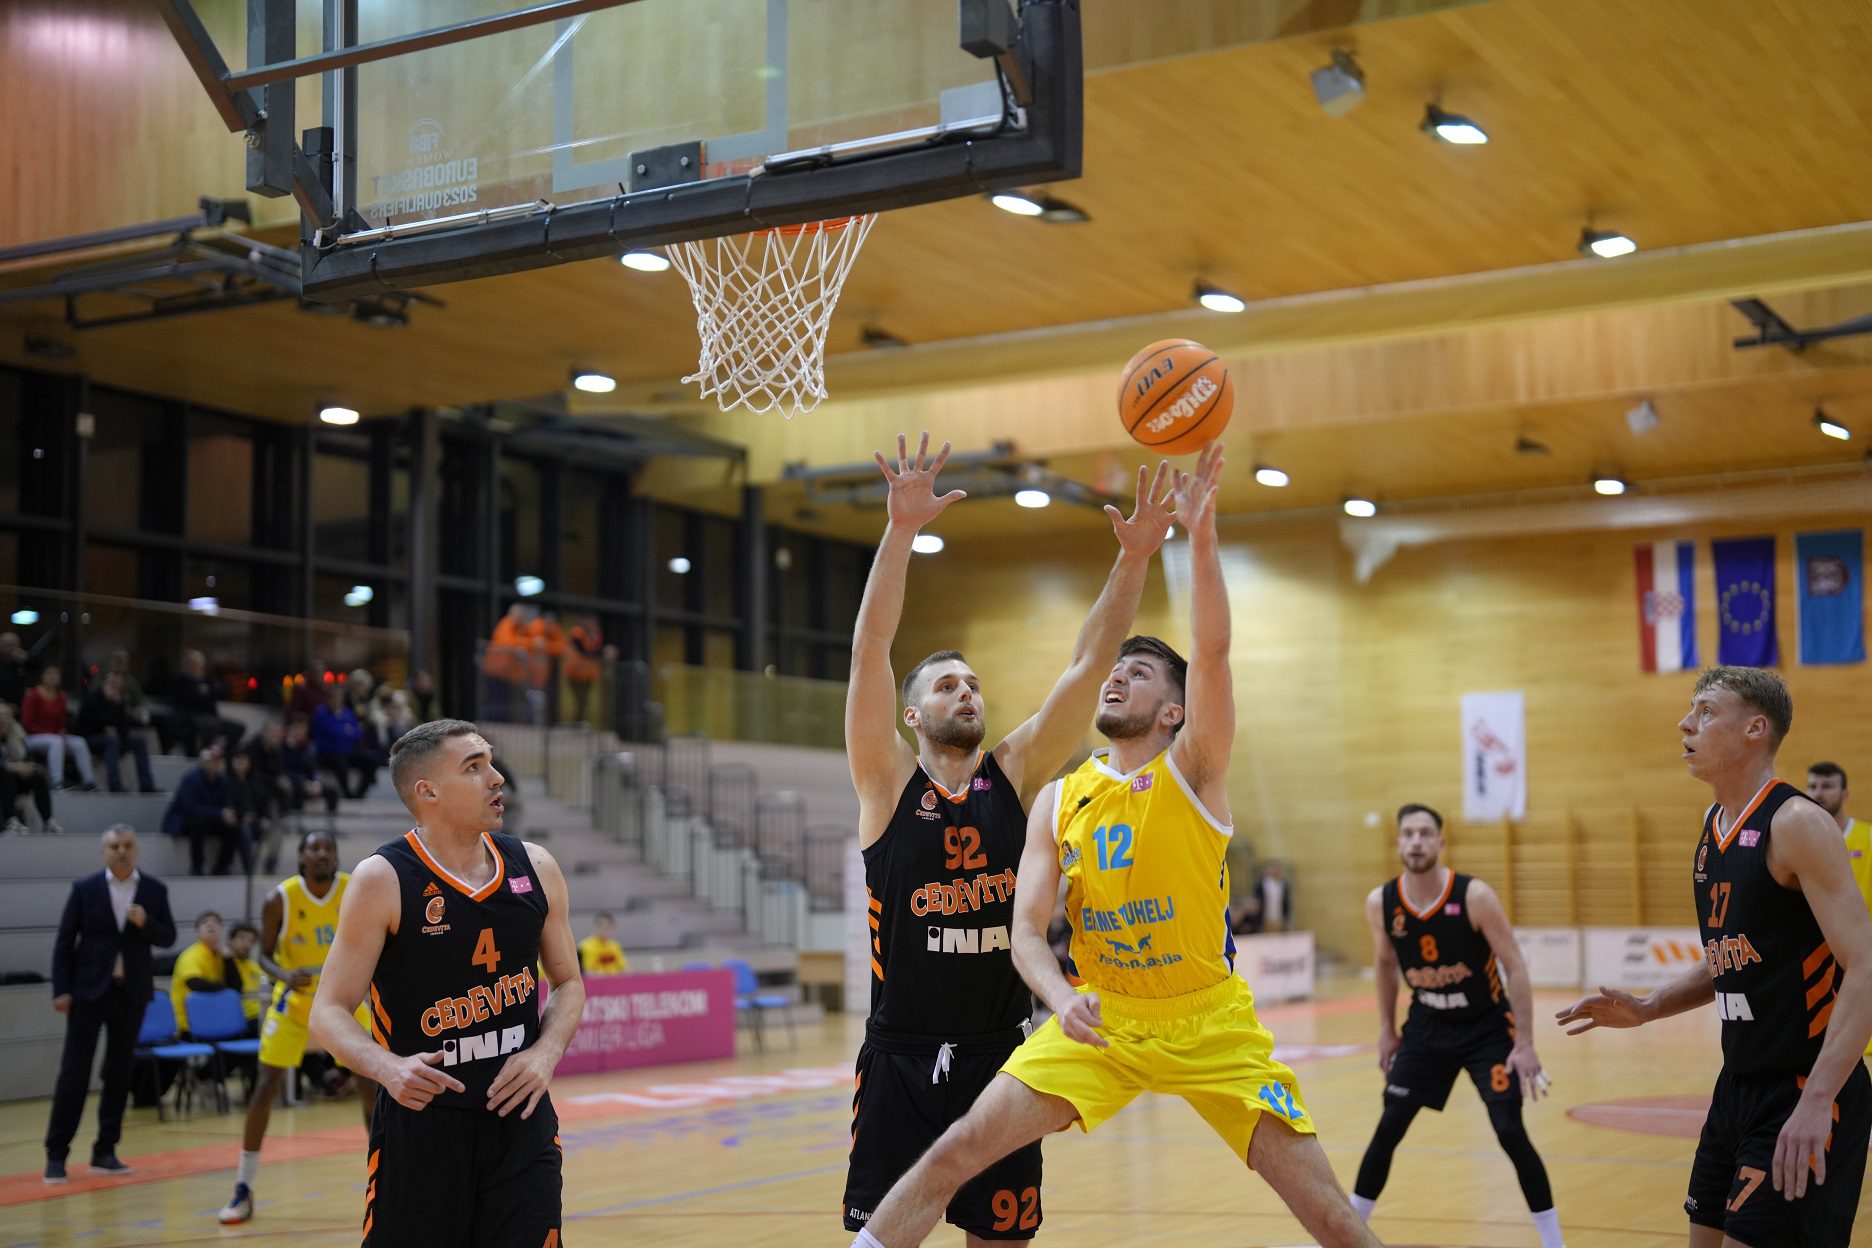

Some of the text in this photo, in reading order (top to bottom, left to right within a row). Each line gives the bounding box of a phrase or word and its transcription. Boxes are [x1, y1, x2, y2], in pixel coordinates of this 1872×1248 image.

[944, 826, 988, 870] 92
[1092, 823, 1134, 871] 12
[911, 867, 1017, 917] CEDEVITA
[1708, 881, 1731, 928] 17
[471, 927, 501, 974] 4
[1419, 934, 1439, 963] 8
[421, 966, 536, 1037] CEDEVITA
[1259, 1081, 1304, 1119] 12
[1491, 1064, 1510, 1093] 8
[991, 1186, 1039, 1232] 92
